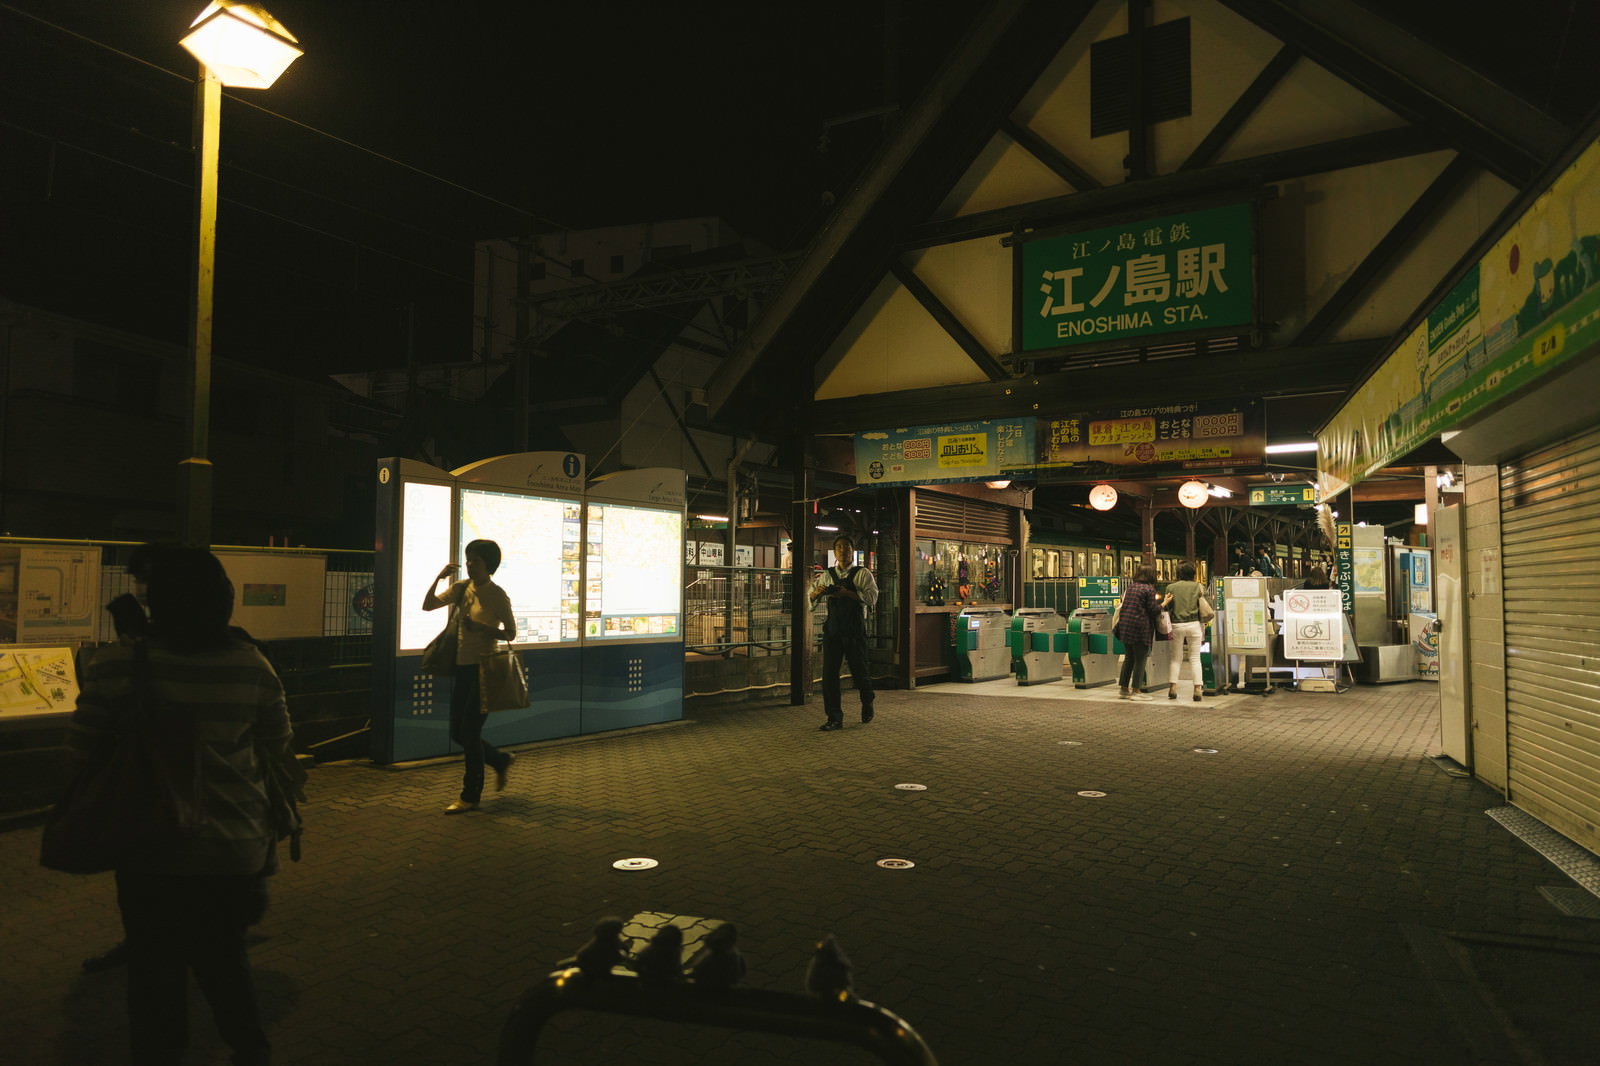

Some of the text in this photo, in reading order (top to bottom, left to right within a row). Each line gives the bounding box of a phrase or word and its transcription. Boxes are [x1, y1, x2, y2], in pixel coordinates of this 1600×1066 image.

[1072, 222, 1192, 260] 江ノ島電鉄
[1039, 242, 1229, 319] 江ノ島駅
[1057, 304, 1209, 338] ENOSHIMA STA.
[1160, 414, 1238, 429] おとな 1000円
[1160, 425, 1238, 440] こども 500円
[1339, 550, 1352, 611] きっぷうりば
